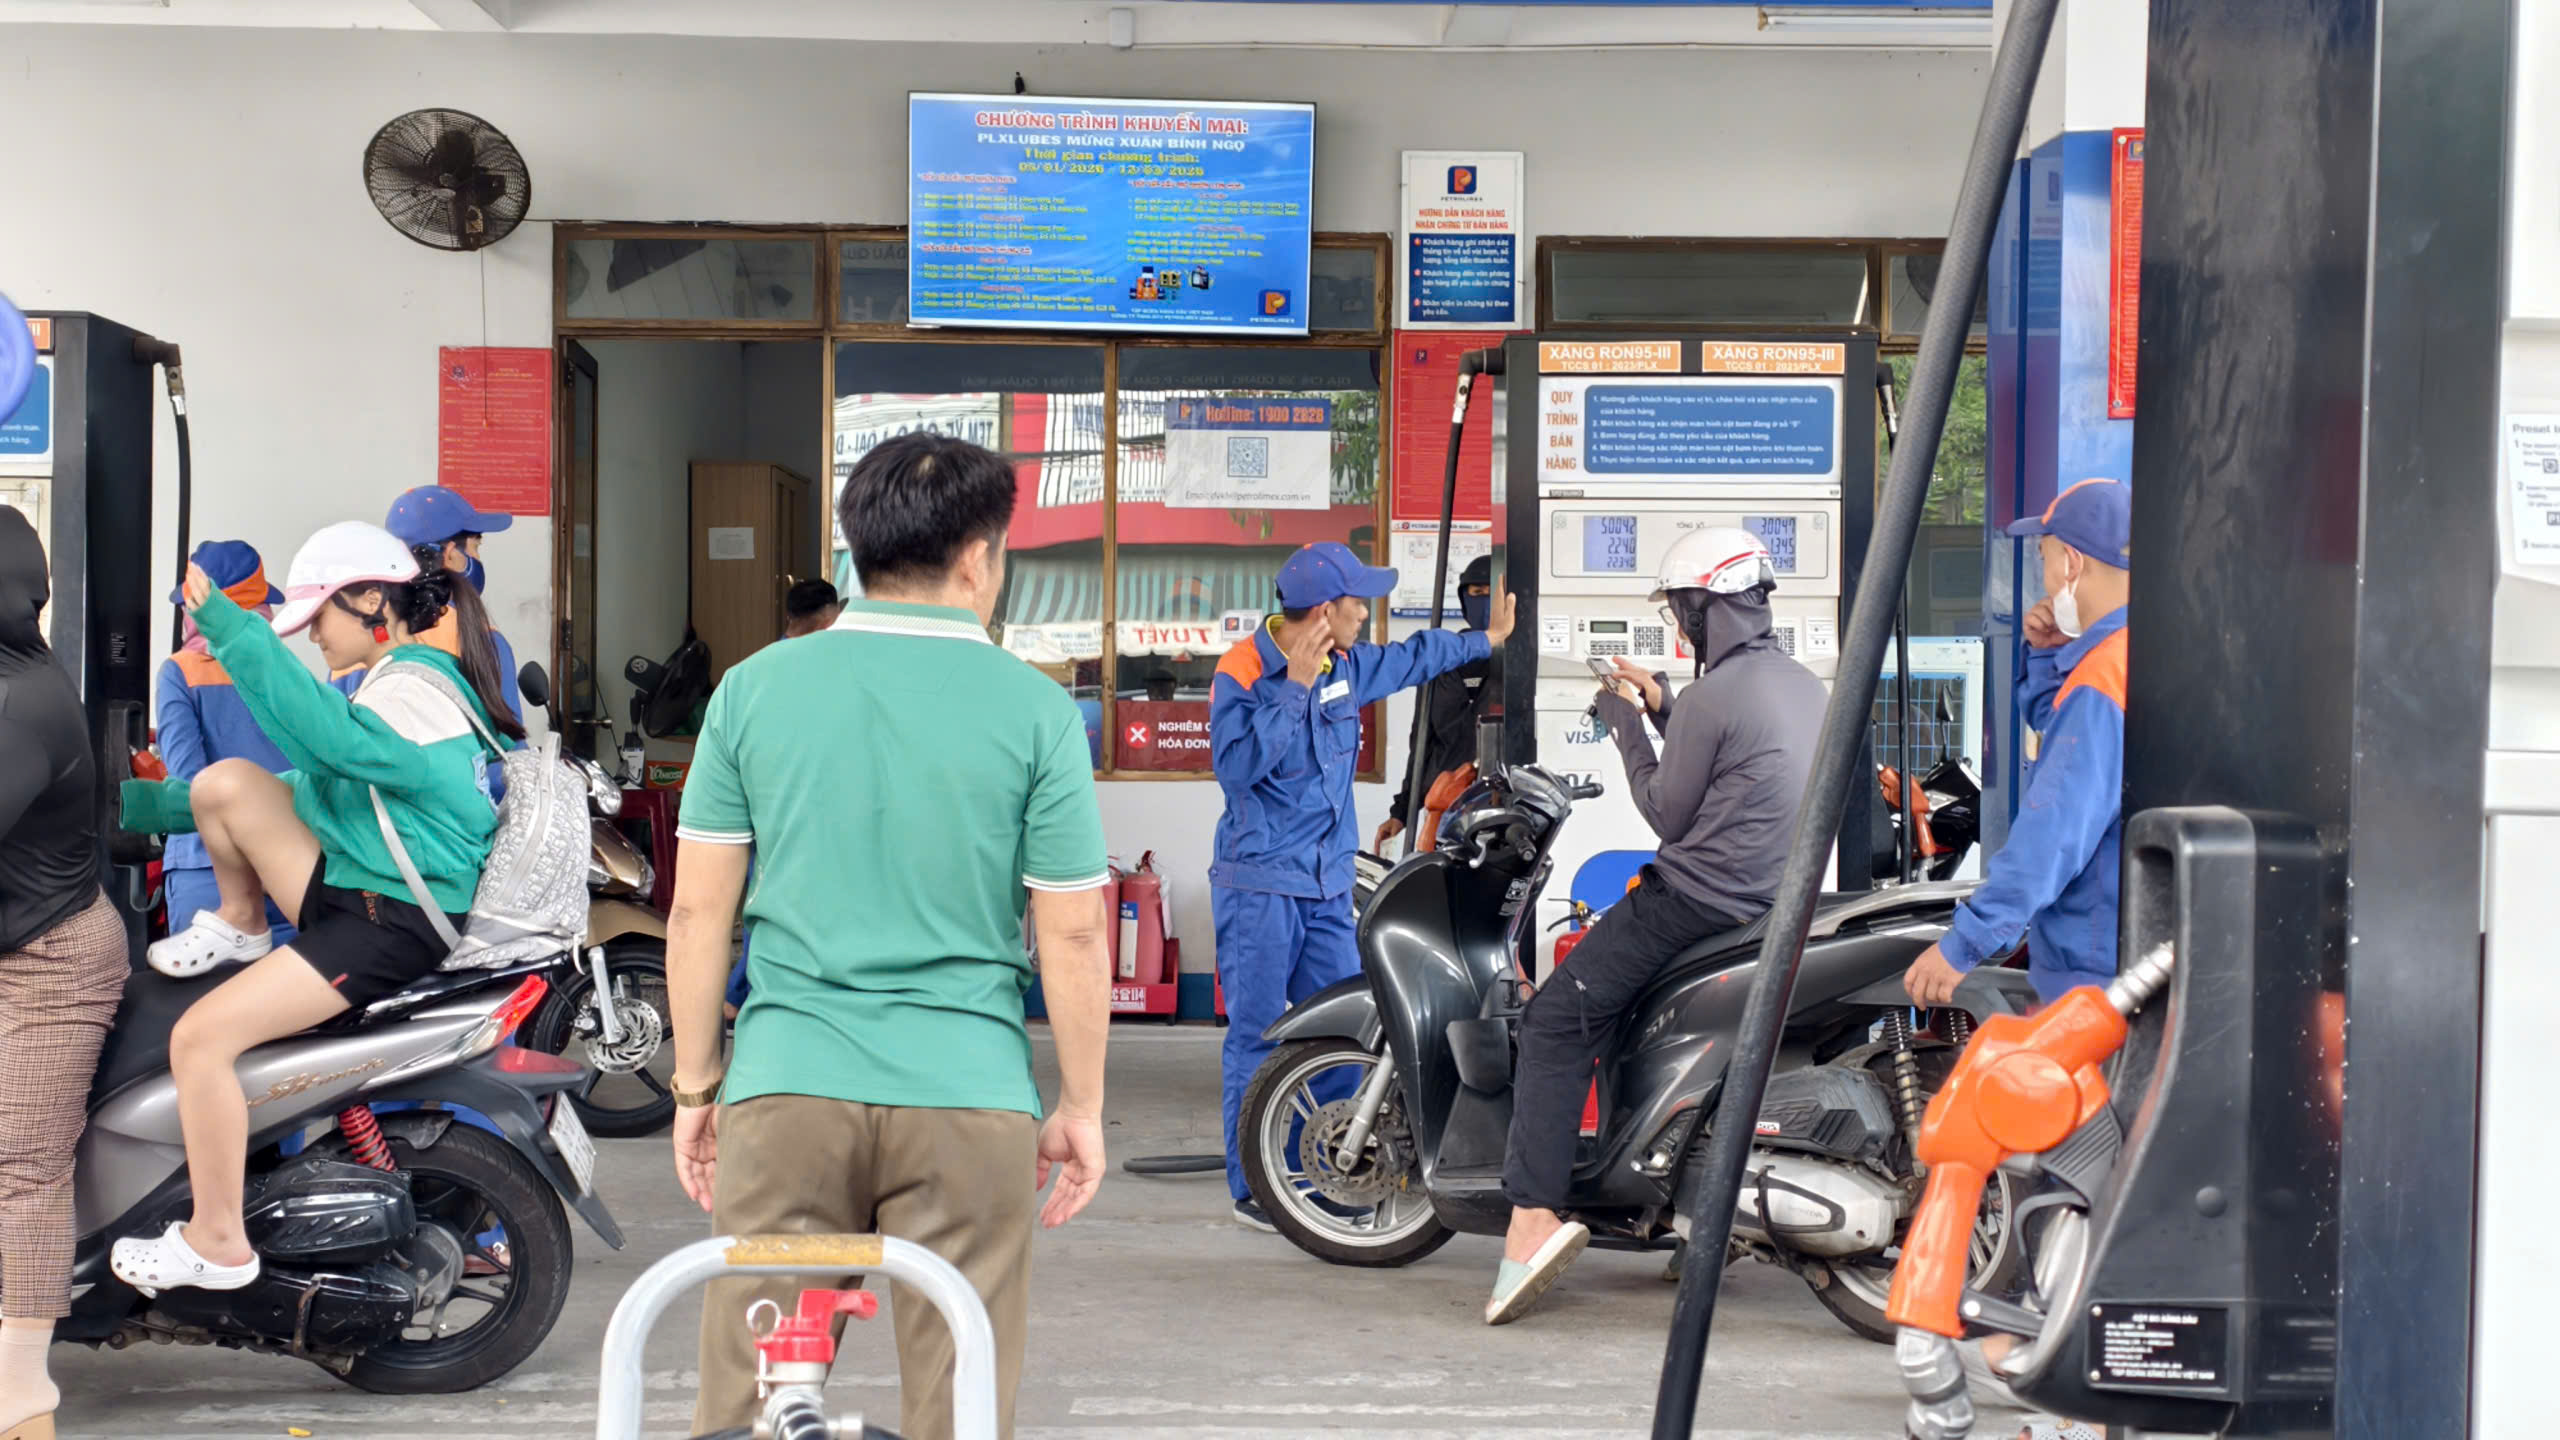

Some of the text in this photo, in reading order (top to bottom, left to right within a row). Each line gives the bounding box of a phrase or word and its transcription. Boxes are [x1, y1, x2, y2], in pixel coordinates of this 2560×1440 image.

[976, 111, 1248, 136] CHƯƠNG TRÌNH KHUYẾN MẠI:
[1549, 344, 1671, 360] XĂNG RON95-III
[1712, 344, 1835, 361] XĂNG RON95-III
[1551, 391, 1573, 405] QUY
[1206, 405, 1325, 424] Hotline: 1900 2828
[1545, 409, 1578, 425] TRÌNH
[1549, 431, 1573, 447] BÁN
[1546, 452, 1577, 470] HÀNG
[1158, 719, 1202, 732] NGHIÊM
[1157, 737, 1210, 749] HÓA ĐƠN
